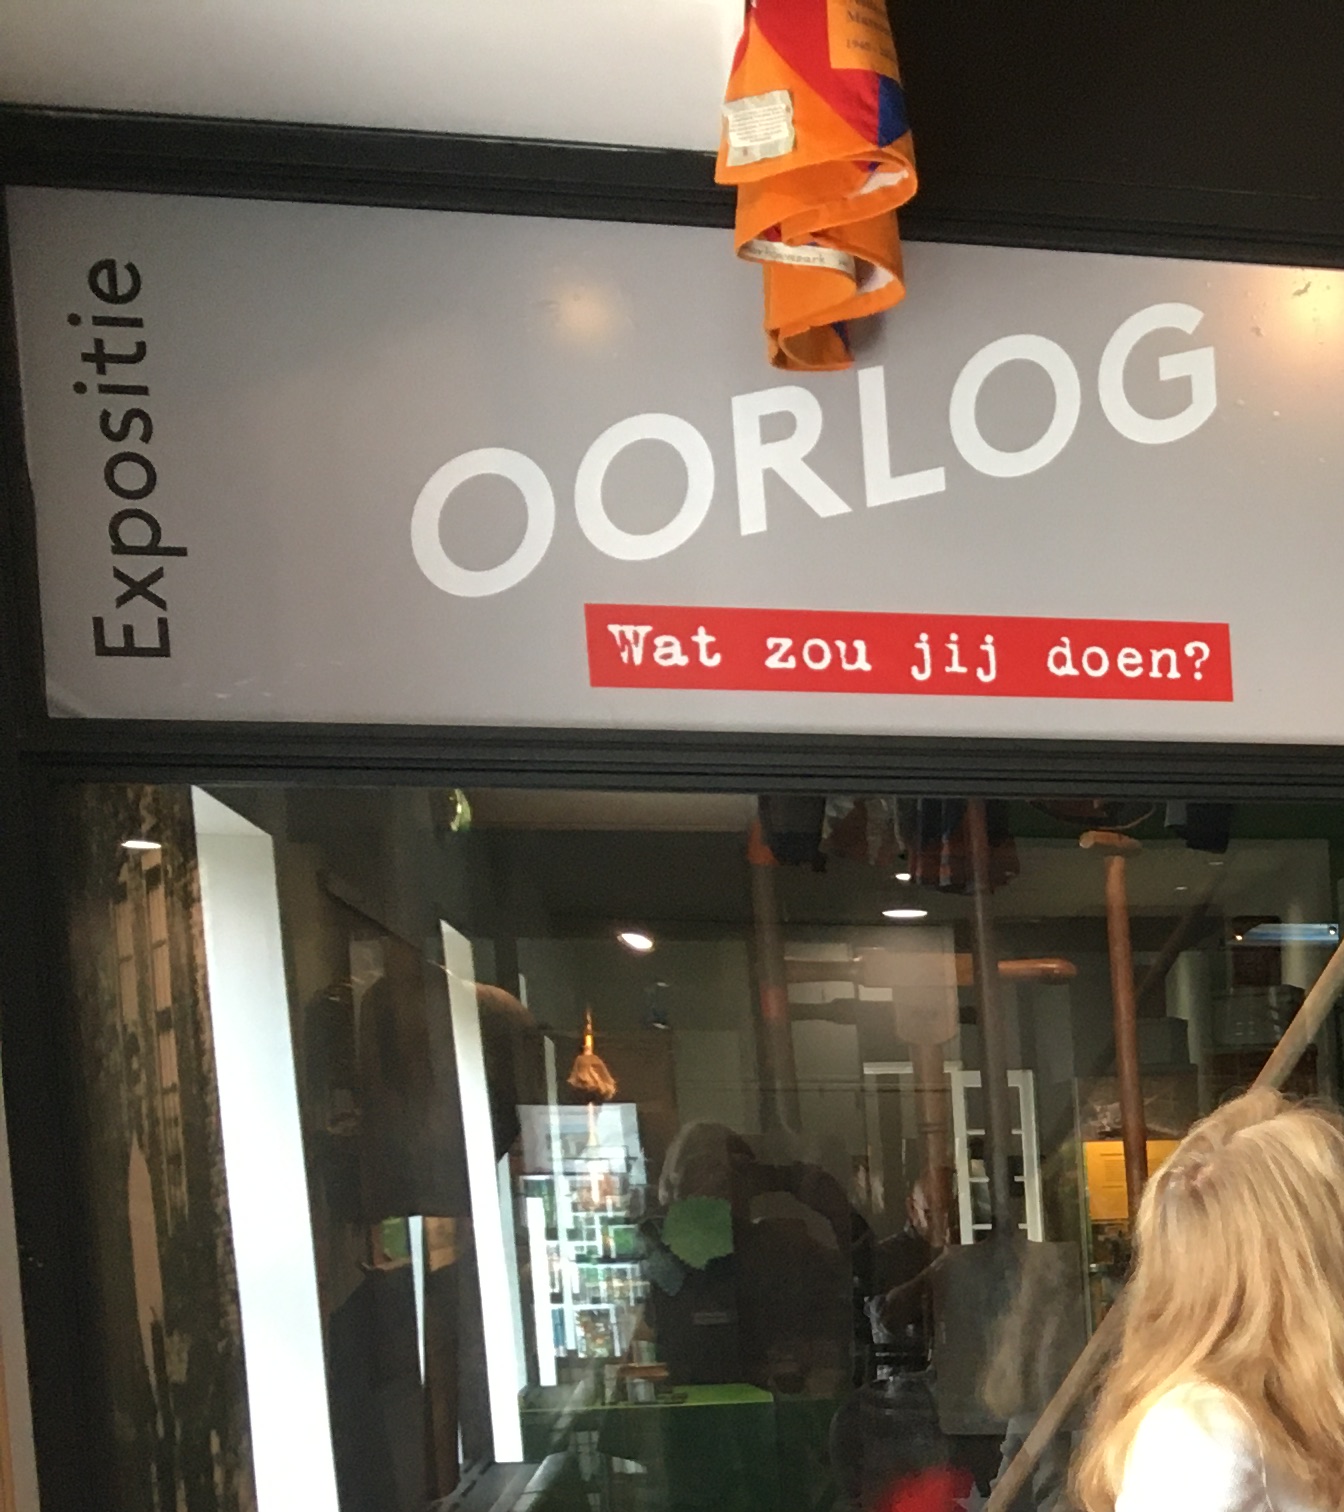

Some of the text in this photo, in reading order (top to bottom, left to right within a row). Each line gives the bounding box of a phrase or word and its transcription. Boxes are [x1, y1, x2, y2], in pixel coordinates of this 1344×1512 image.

[67, 257, 188, 660] Expositie
[412, 303, 1217, 597] OORLOG
[607, 624, 1212, 683] Wat zou jij doen?
